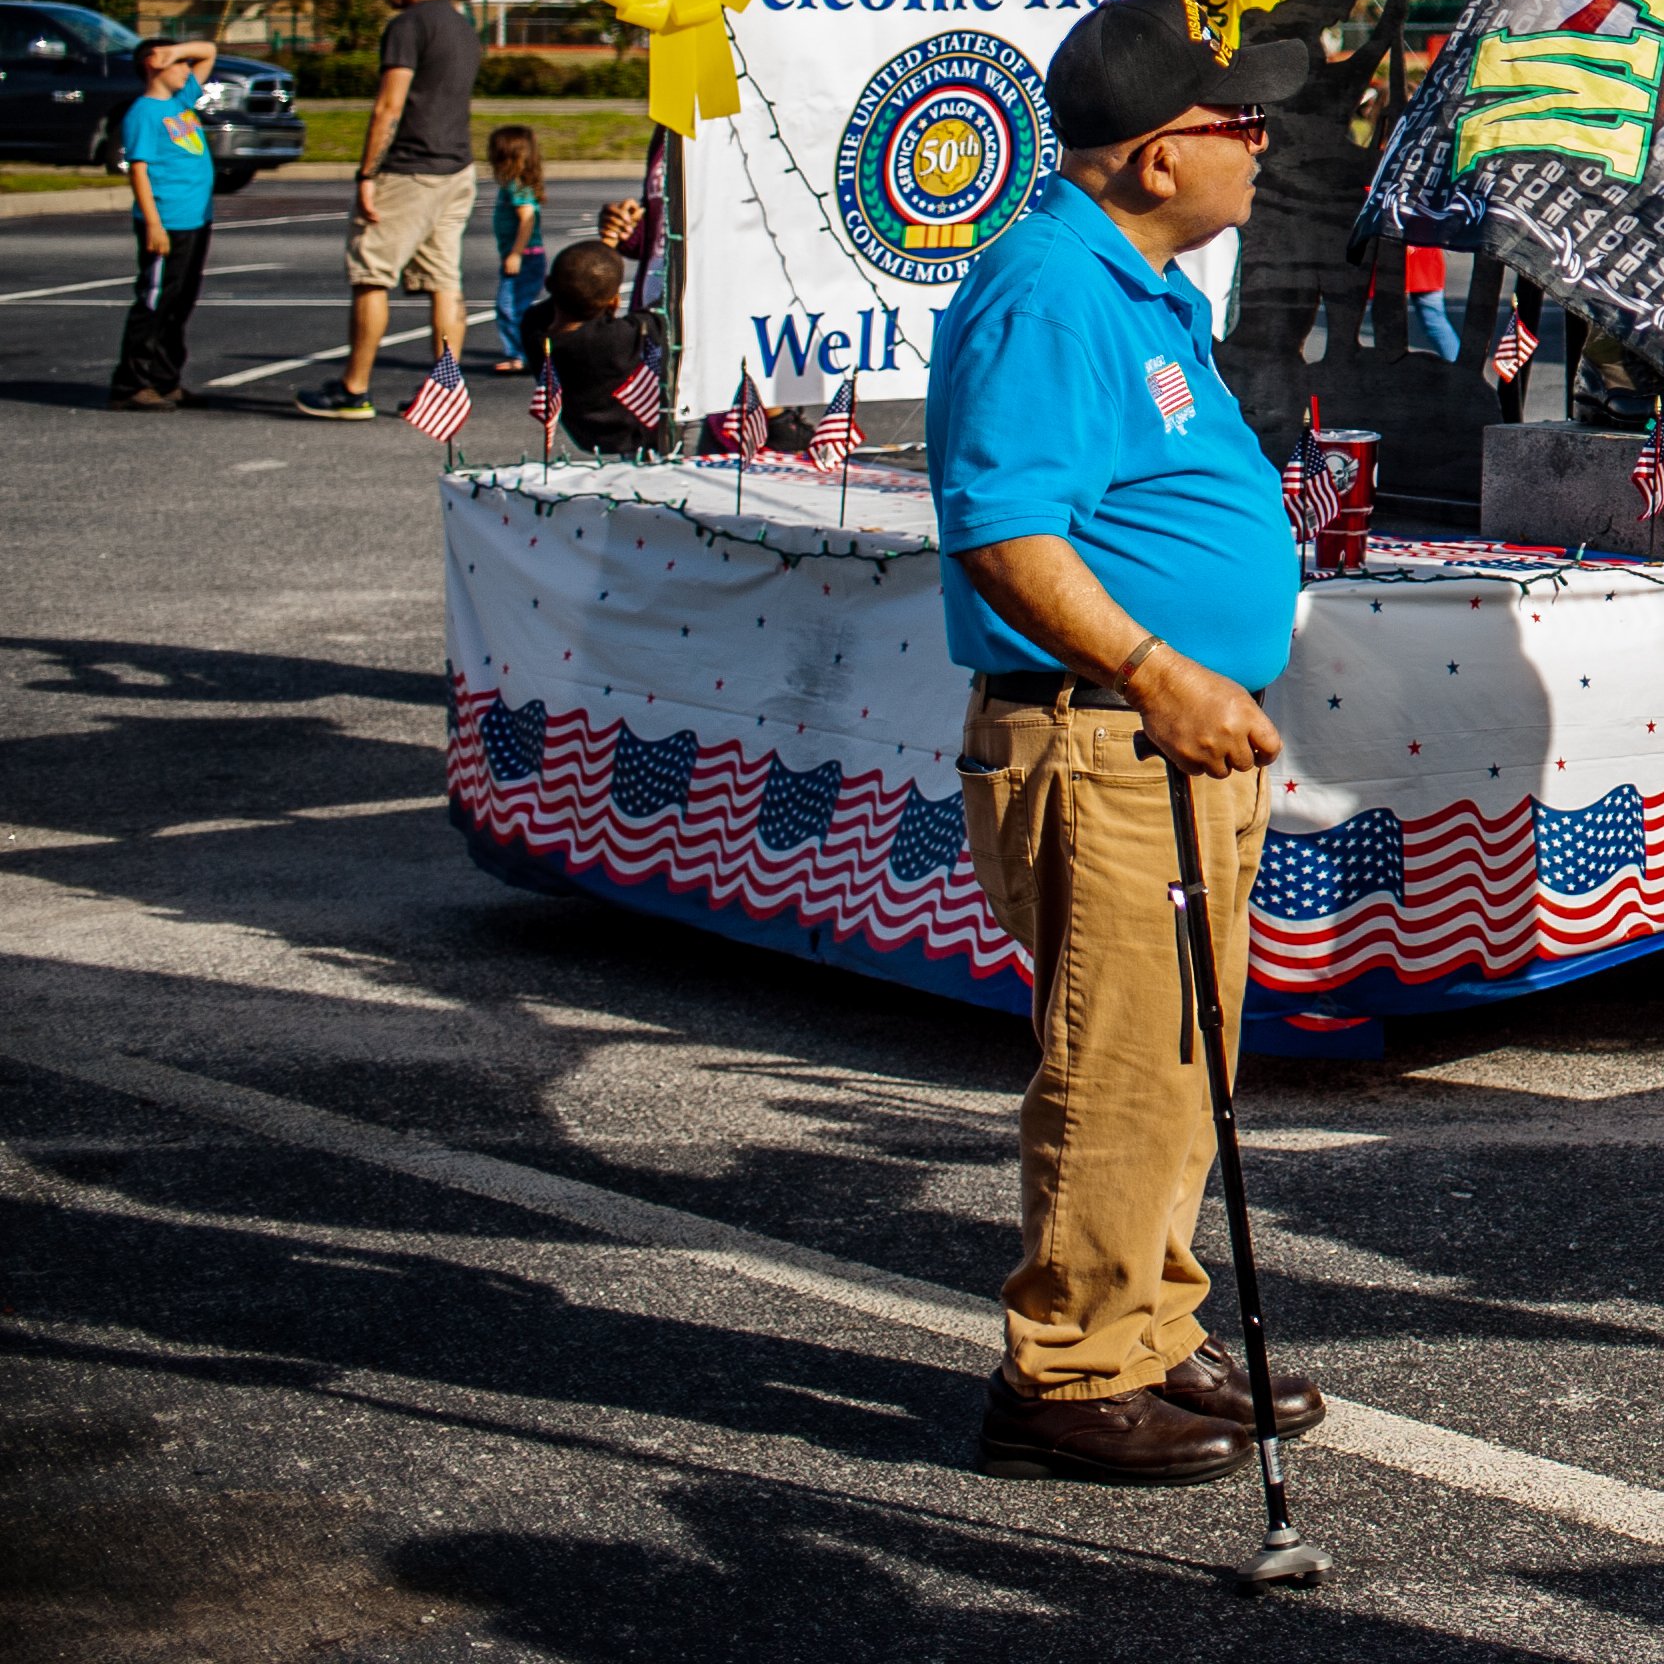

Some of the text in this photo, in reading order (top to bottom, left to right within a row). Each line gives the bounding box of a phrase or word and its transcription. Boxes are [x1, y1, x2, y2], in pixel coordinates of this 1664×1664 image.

[838, 33, 1057, 186] THE UNITED STATES OF AMERICA
[890, 60, 1018, 108] VIETNAM WAR
[928, 101, 976, 120] VALOR
[897, 131, 920, 193] SERVICE
[919, 134, 981, 177] 50th
[976, 126, 998, 191] SACRIFICE
[845, 209, 974, 283] COMMEMOR
[750, 307, 901, 378] Well
